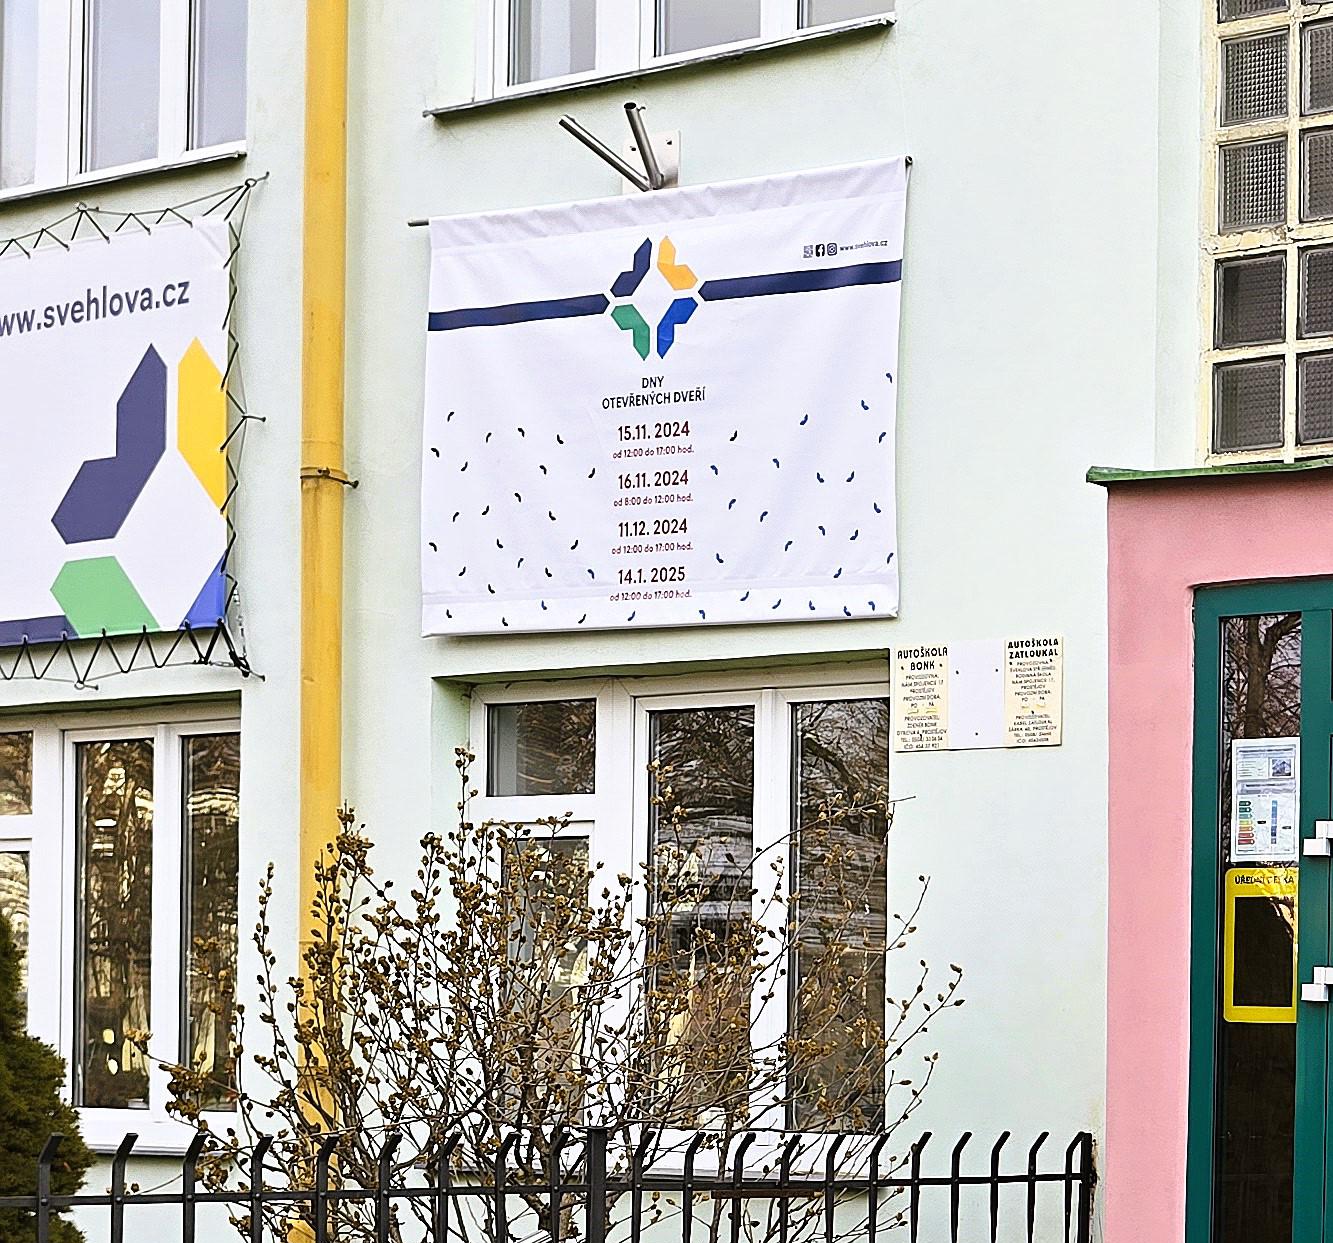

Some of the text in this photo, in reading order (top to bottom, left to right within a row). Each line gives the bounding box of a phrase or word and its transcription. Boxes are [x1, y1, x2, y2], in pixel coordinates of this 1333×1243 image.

[642, 376, 665, 389] DNY
[602, 386, 706, 409] OTEVŘENÝCH DVEŘÍ
[618, 421, 690, 441] 15.11. 2024
[612, 450, 622, 459] od
[623, 448, 644, 458] 12:00
[645, 448, 655, 457] do
[656, 446, 676, 455] 17:00
[618, 469, 689, 489] 16.11. 2024
[643, 496, 653, 505] do
[654, 494, 675, 504] 12:00
[618, 518, 688, 538] 11.12. 2024
[611, 546, 622, 555] od
[623, 544, 643, 554] 12:00
[644, 544, 654, 553] do
[655, 542, 675, 552] 17:00
[618, 566, 686, 585] 14.1. 2025
[621, 592, 642, 601] 12:00
[642, 591, 653, 600] do
[1008, 638, 1059, 649] AUTOŠKOLA
[897, 646, 948, 660] AUTOŠKOLA
[1009, 648, 1059, 660] ZATLOUKAL
[910, 660, 935, 671] BONK
